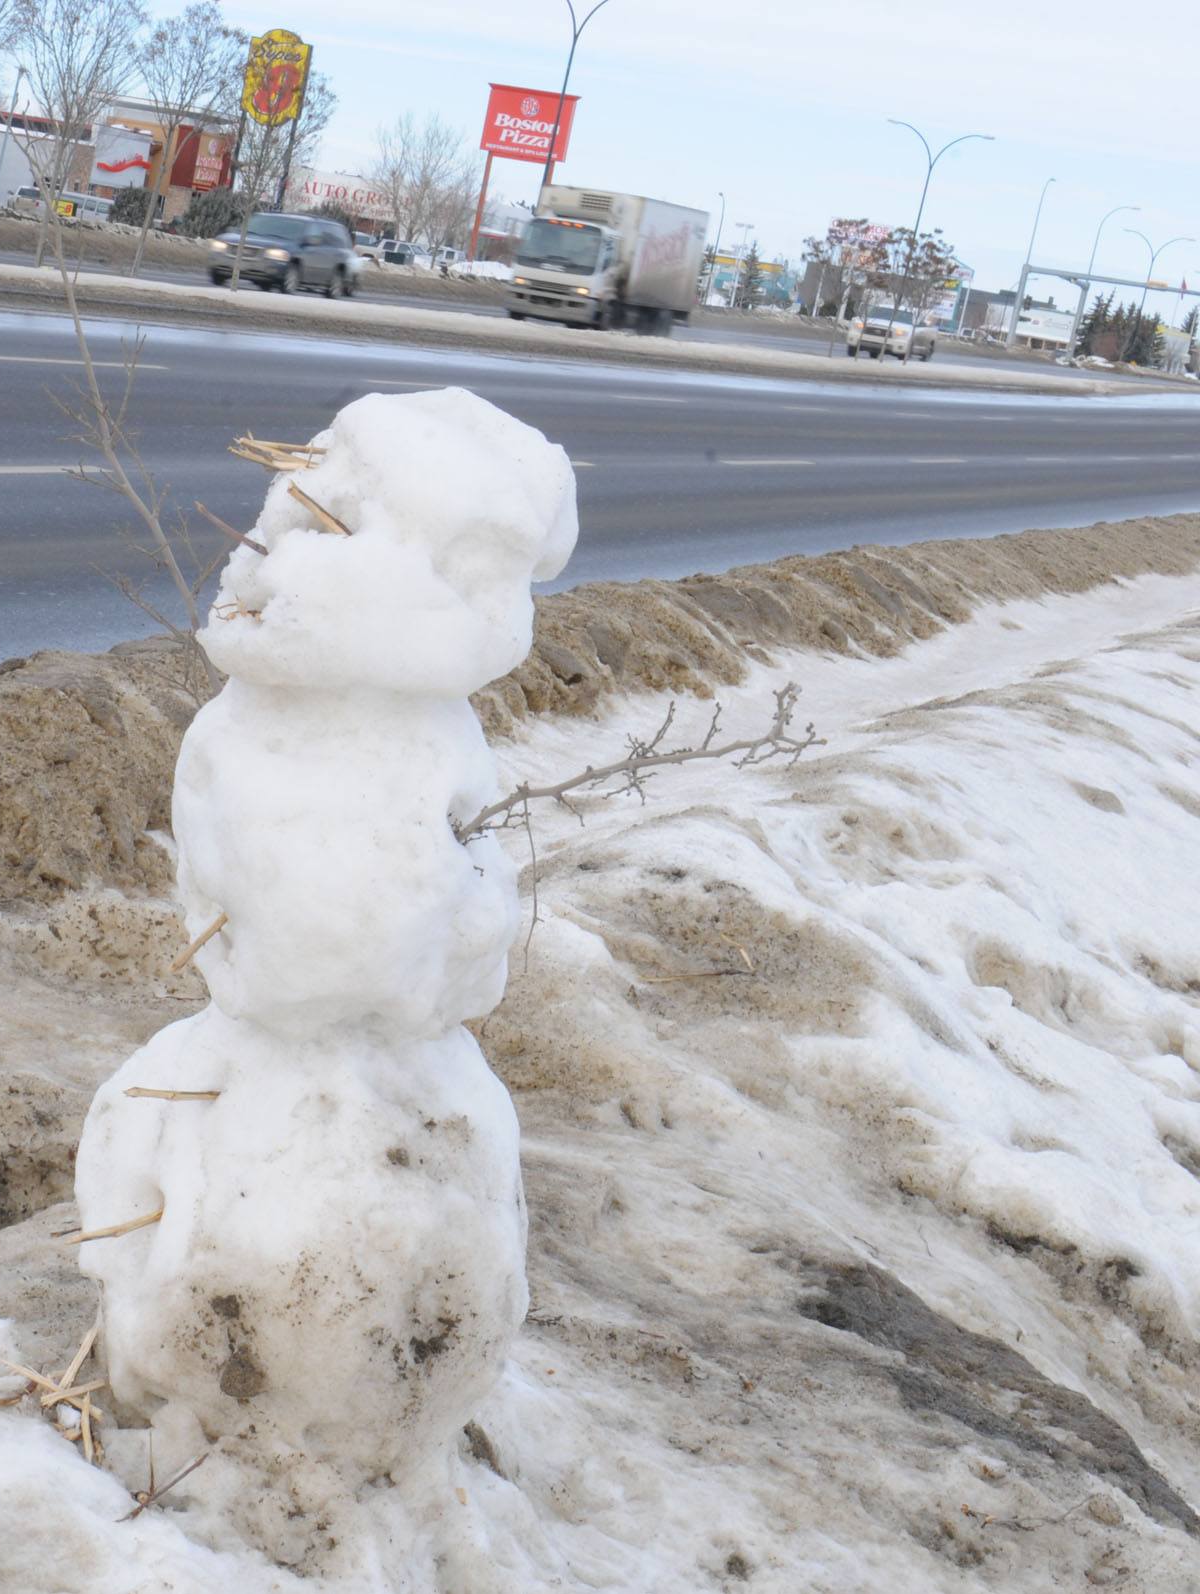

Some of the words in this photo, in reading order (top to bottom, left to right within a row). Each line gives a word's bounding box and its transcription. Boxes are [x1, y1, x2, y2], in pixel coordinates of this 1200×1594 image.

[253, 64, 303, 114] 8
[494, 112, 560, 135] Boston
[499, 128, 550, 149] Pizza
[303, 179, 348, 200] AUTO
